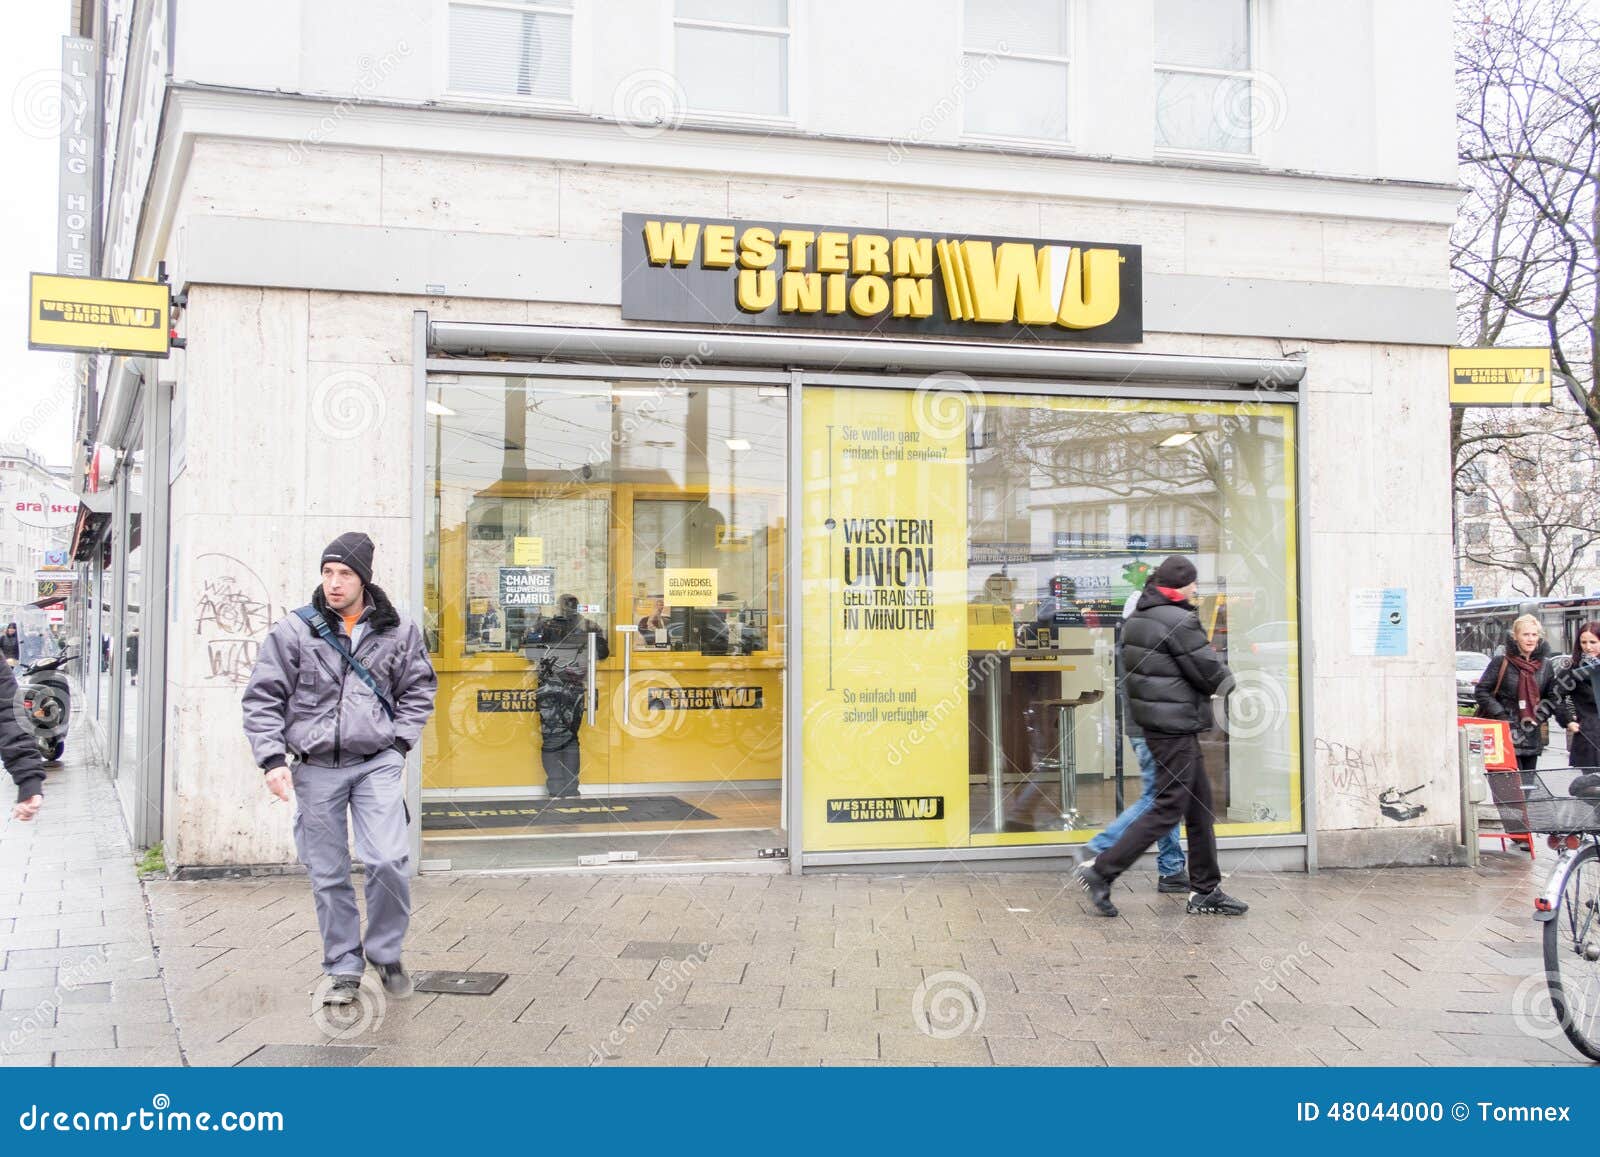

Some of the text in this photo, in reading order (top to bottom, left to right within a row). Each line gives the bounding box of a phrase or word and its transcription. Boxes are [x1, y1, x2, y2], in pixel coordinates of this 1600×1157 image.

[68, 59, 88, 175] LIVING
[643, 220, 934, 281] WESTERN
[950, 239, 1120, 330] WU
[735, 267, 934, 318] UNION
[42, 300, 111, 316] WESTERN
[63, 311, 111, 324] UNION
[116, 306, 156, 327] WU
[1455, 368, 1506, 377] WESTERN
[1471, 374, 1506, 383] UNION
[842, 425, 920, 446] Sie wollen ganz
[842, 444, 879, 461] einfach
[882, 445, 904, 461] Geld
[15, 501, 42, 512] ara
[843, 518, 934, 545] WESTERN
[844, 547, 934, 587] UNION
[505, 575, 551, 586] CHANGE
[668, 577, 713, 588] GELDWECHSEL
[505, 585, 551, 593] GELDWECHSEL
[668, 588, 687, 597] MONEY
[505, 592, 551, 604] CAMBIO
[843, 588, 934, 607] GELDTRANSFER
[843, 608, 935, 630] IN MINUTEN
[480, 691, 537, 702] WESTER
[650, 688, 714, 699] WESTERN
[843, 688, 917, 704] So einfach und
[501, 700, 537, 711] UNIO
[670, 698, 714, 708] UNION
[843, 706, 929, 725] schnell verfügbar
[830, 799, 895, 811] WESTERN
[899, 797, 938, 819] WU
[850, 809, 895, 820] UNION
